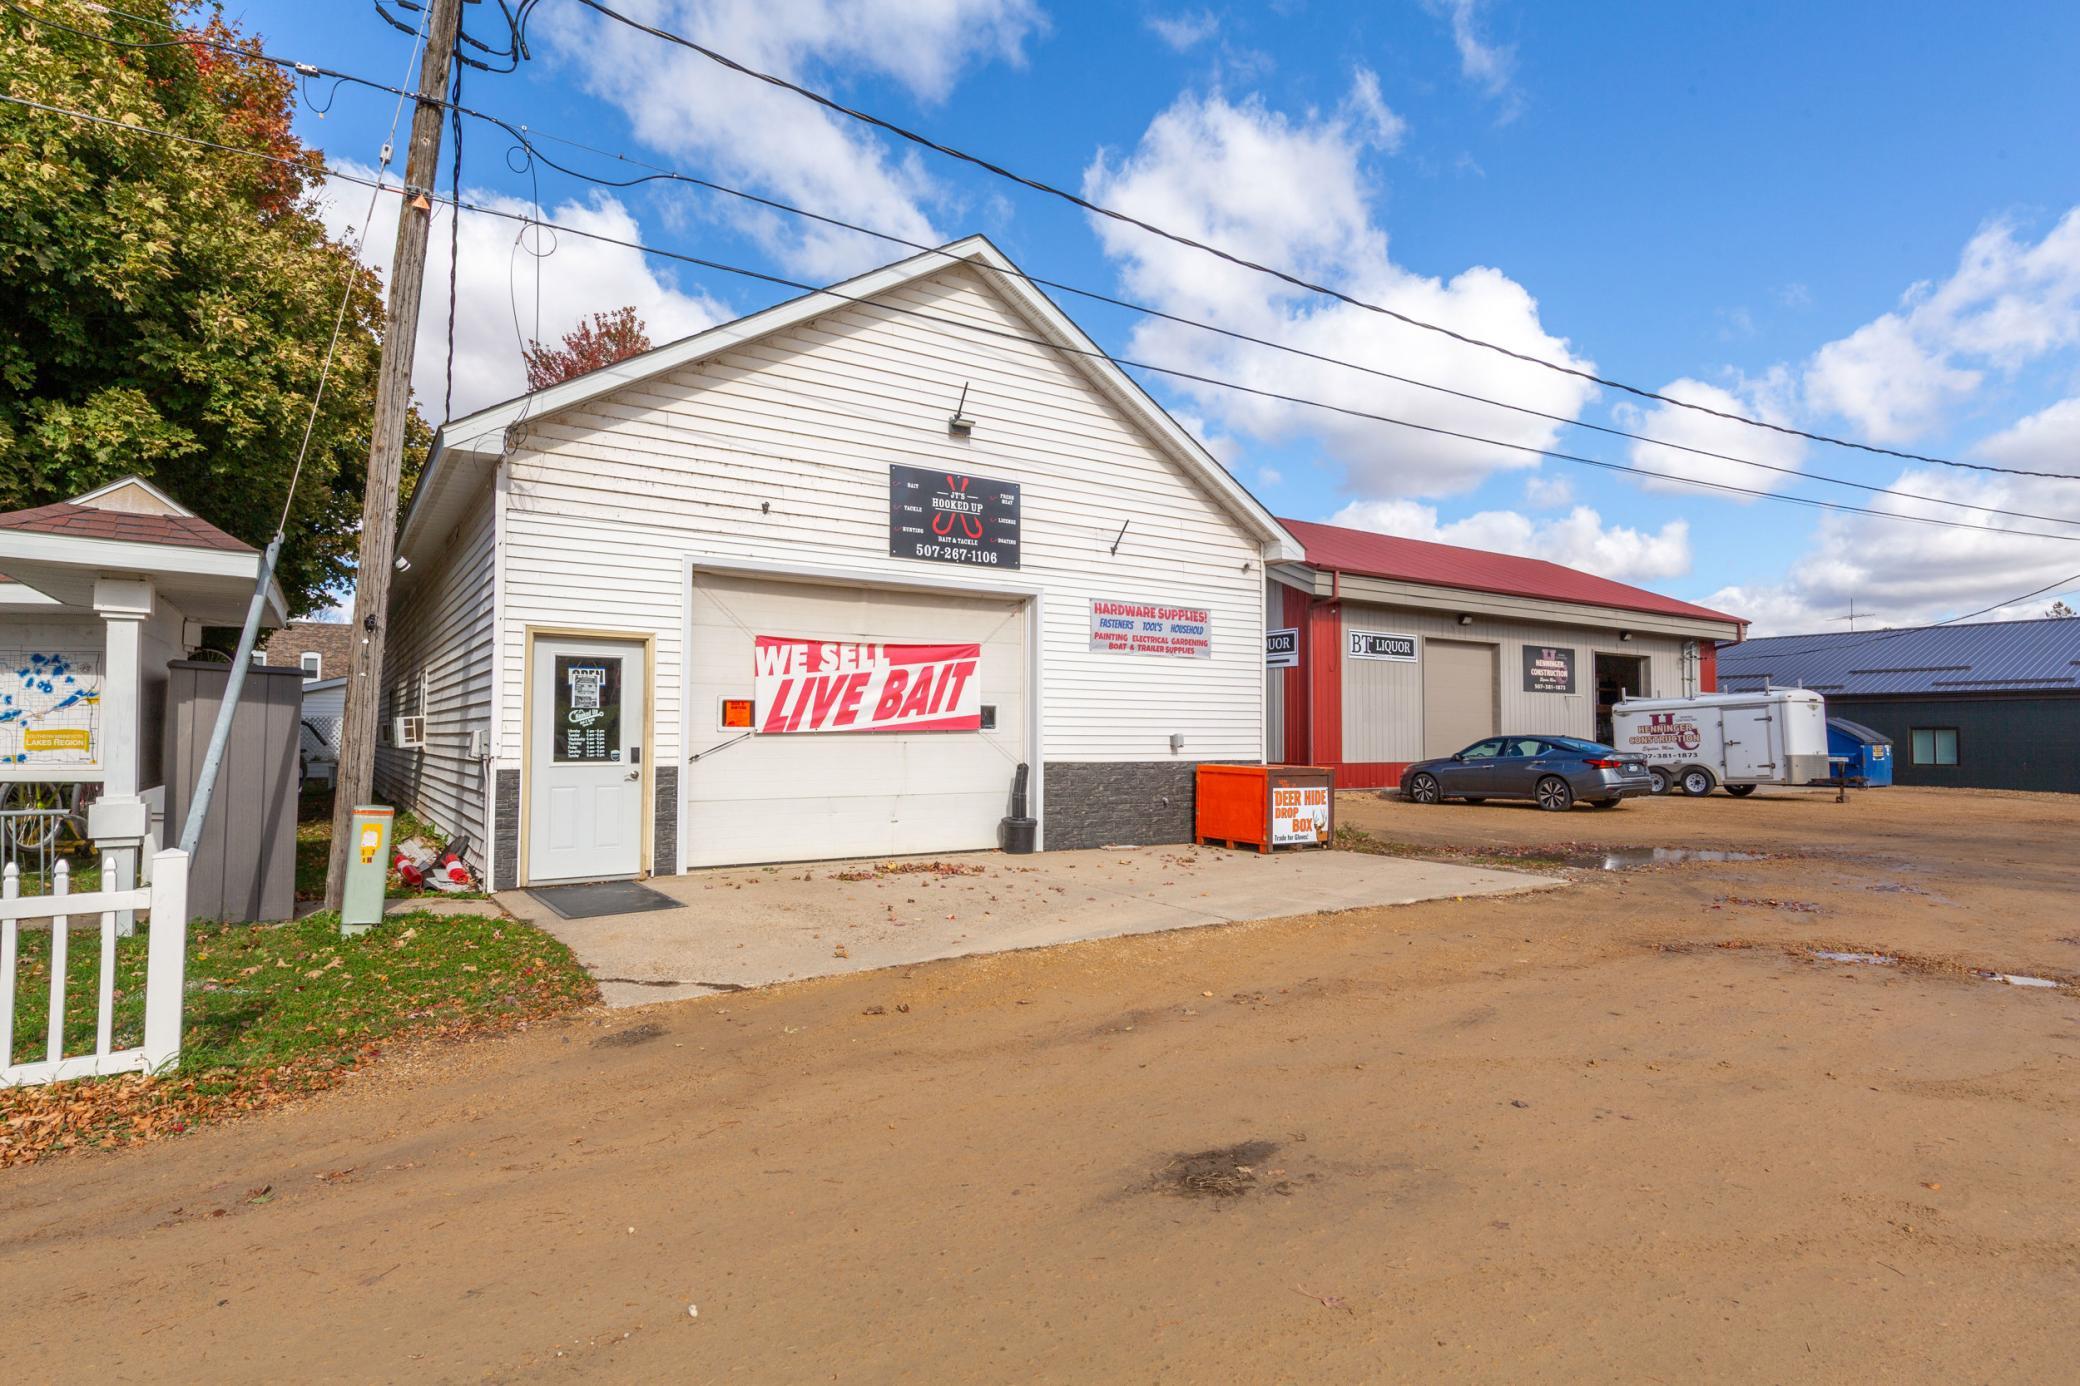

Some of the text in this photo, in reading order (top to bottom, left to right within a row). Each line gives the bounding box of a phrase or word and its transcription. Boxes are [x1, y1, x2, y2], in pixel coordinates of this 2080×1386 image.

[950, 491, 966, 499] JT'S
[932, 497, 984, 513] HOOKED UP
[902, 526, 924, 534] HUNTING
[938, 535, 952, 543] BAIT
[958, 538, 978, 546] TACKLE
[916, 543, 998, 564] 507-267-1106
[1094, 602, 1207, 624] HARDWARE SUPPLIES!
[1100, 618, 1134, 630] FASTENERS
[1170, 624, 1204, 635] HOUSEHOLD
[1094, 632, 1208, 647] PAINTING ELECTRICAL GARDENING
[1266, 637, 1290, 650] UOR
[1352, 634, 1411, 654] BT LIQUOR
[1108, 642, 1127, 650] BOAT
[1137, 644, 1165, 652] TRAILER
[1165, 646, 1195, 655] SUPPLIES
[755, 642, 891, 677] WE SELL
[762, 660, 977, 733] LIVE BAIT
[1637, 723, 1693, 734] HENNINGER
[53, 738, 84, 746] REGION
[1629, 734, 1701, 744] CONSTRUCTION
[1274, 790, 1327, 806] DEER HIDE
[1275, 807, 1299, 818] DROP
[1292, 818, 1312, 832] BOX
